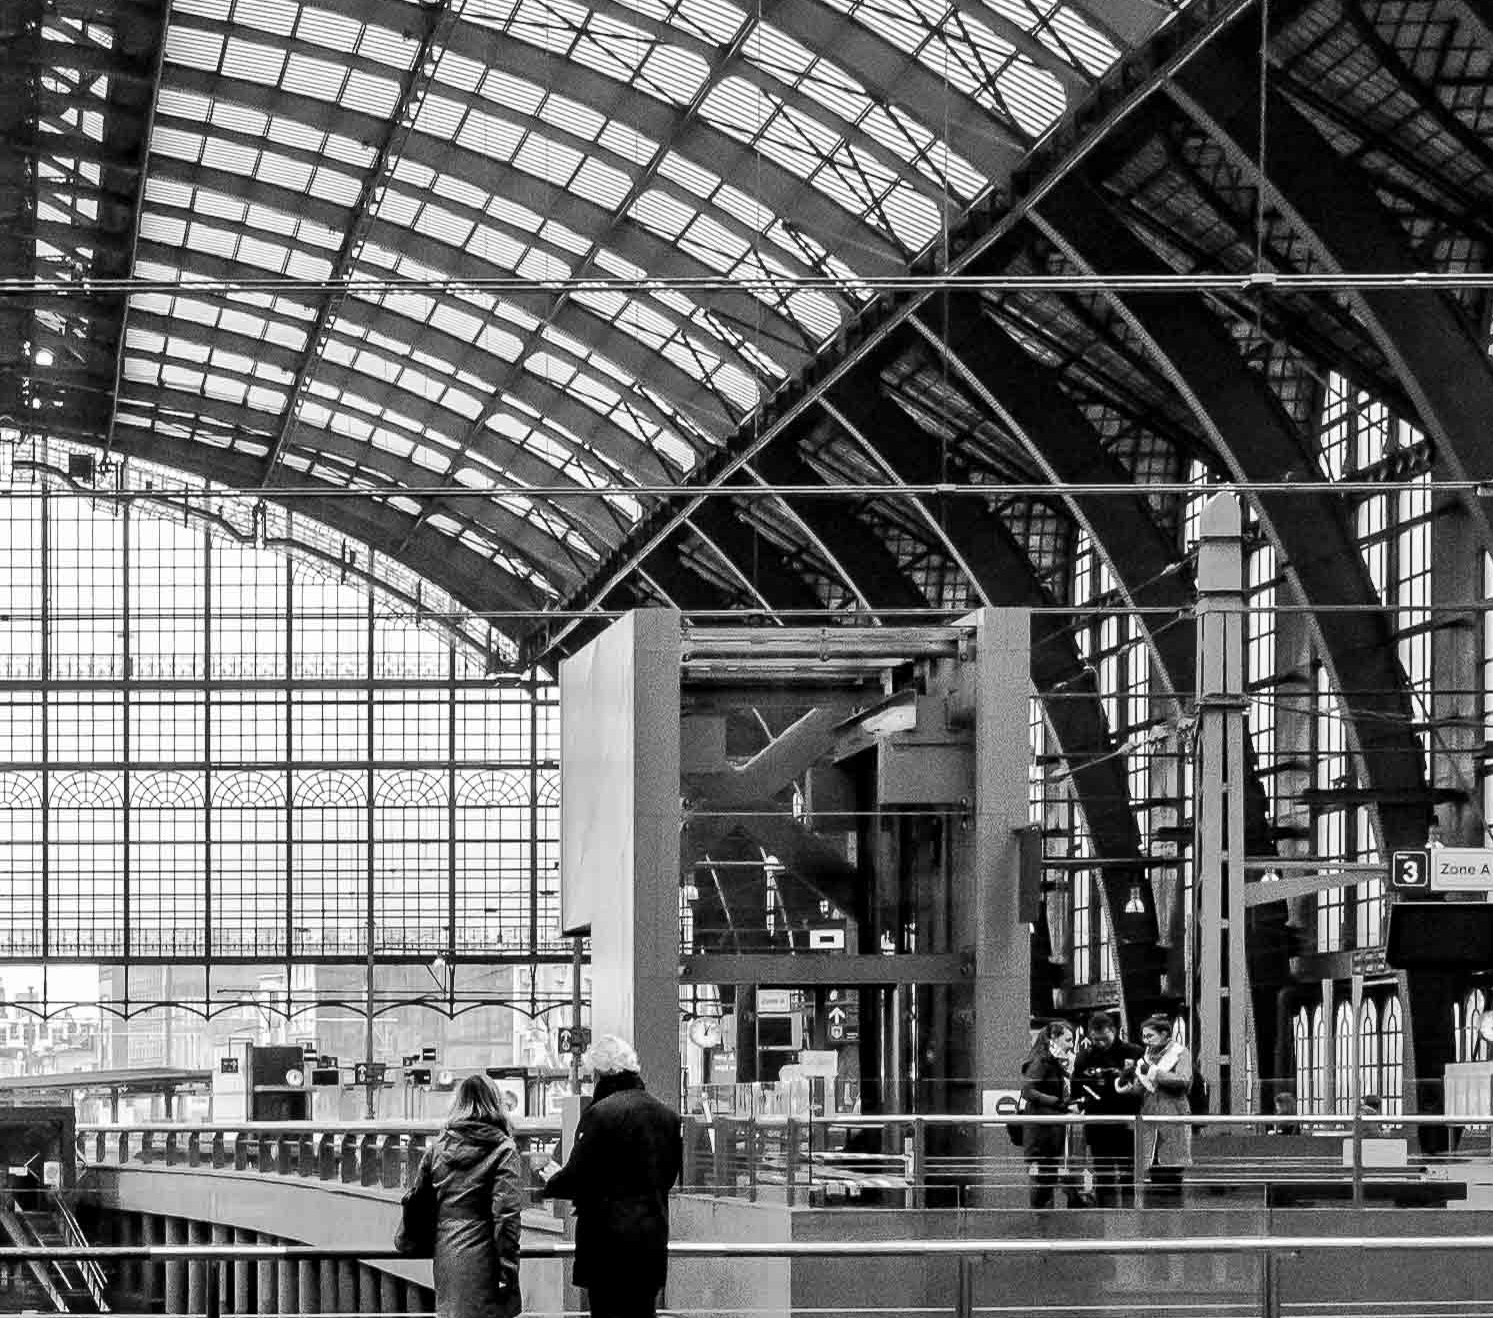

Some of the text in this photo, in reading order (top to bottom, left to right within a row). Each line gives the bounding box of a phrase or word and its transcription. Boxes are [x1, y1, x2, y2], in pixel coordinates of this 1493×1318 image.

[1403, 861, 1418, 883] 3
[1440, 863, 1490, 875] Zone A
